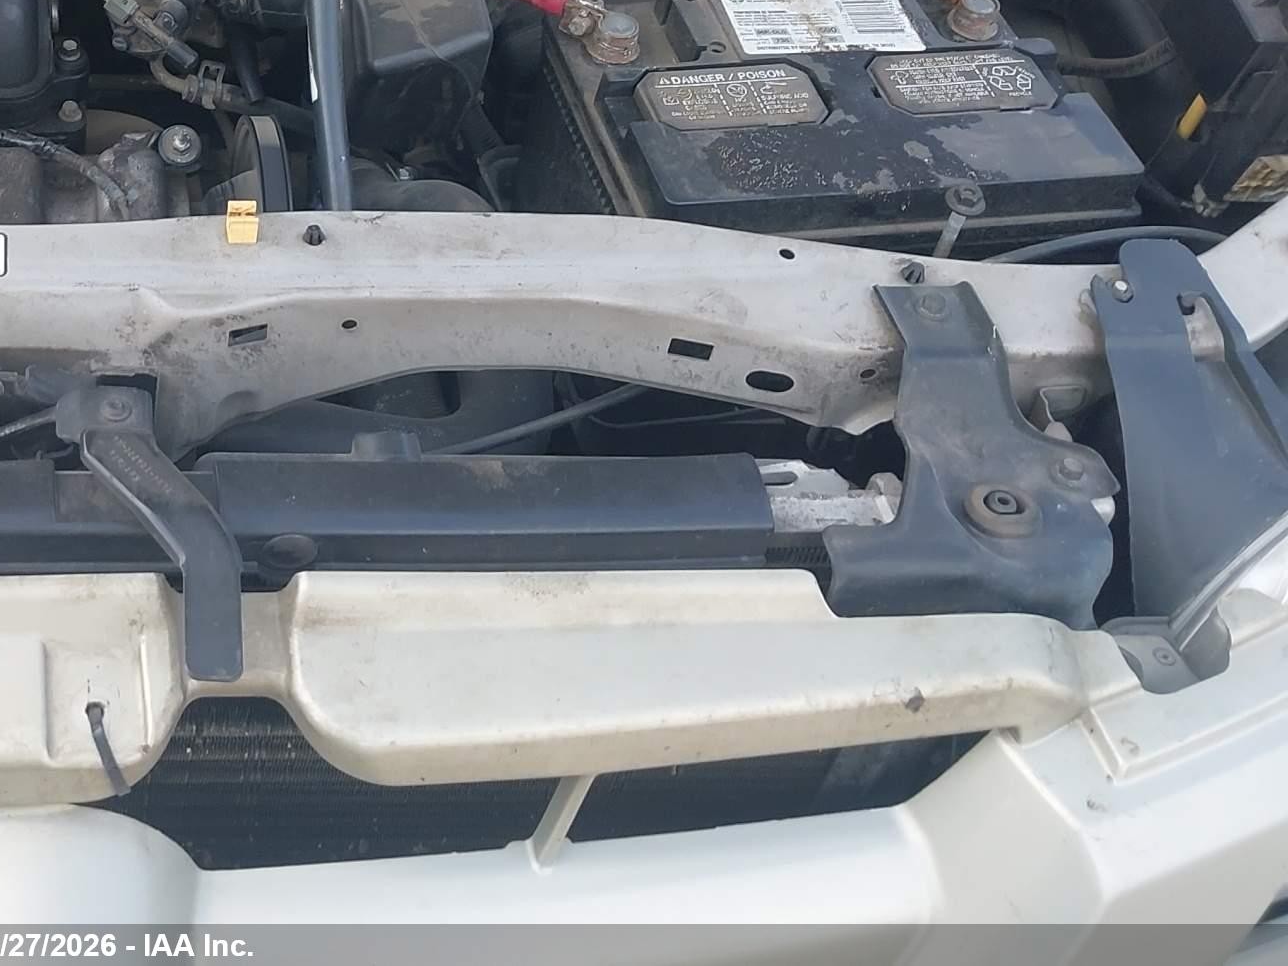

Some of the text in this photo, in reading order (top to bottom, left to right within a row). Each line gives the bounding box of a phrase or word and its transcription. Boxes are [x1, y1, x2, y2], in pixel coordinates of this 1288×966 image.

[670, 69, 786, 85] DANGER / POISON
